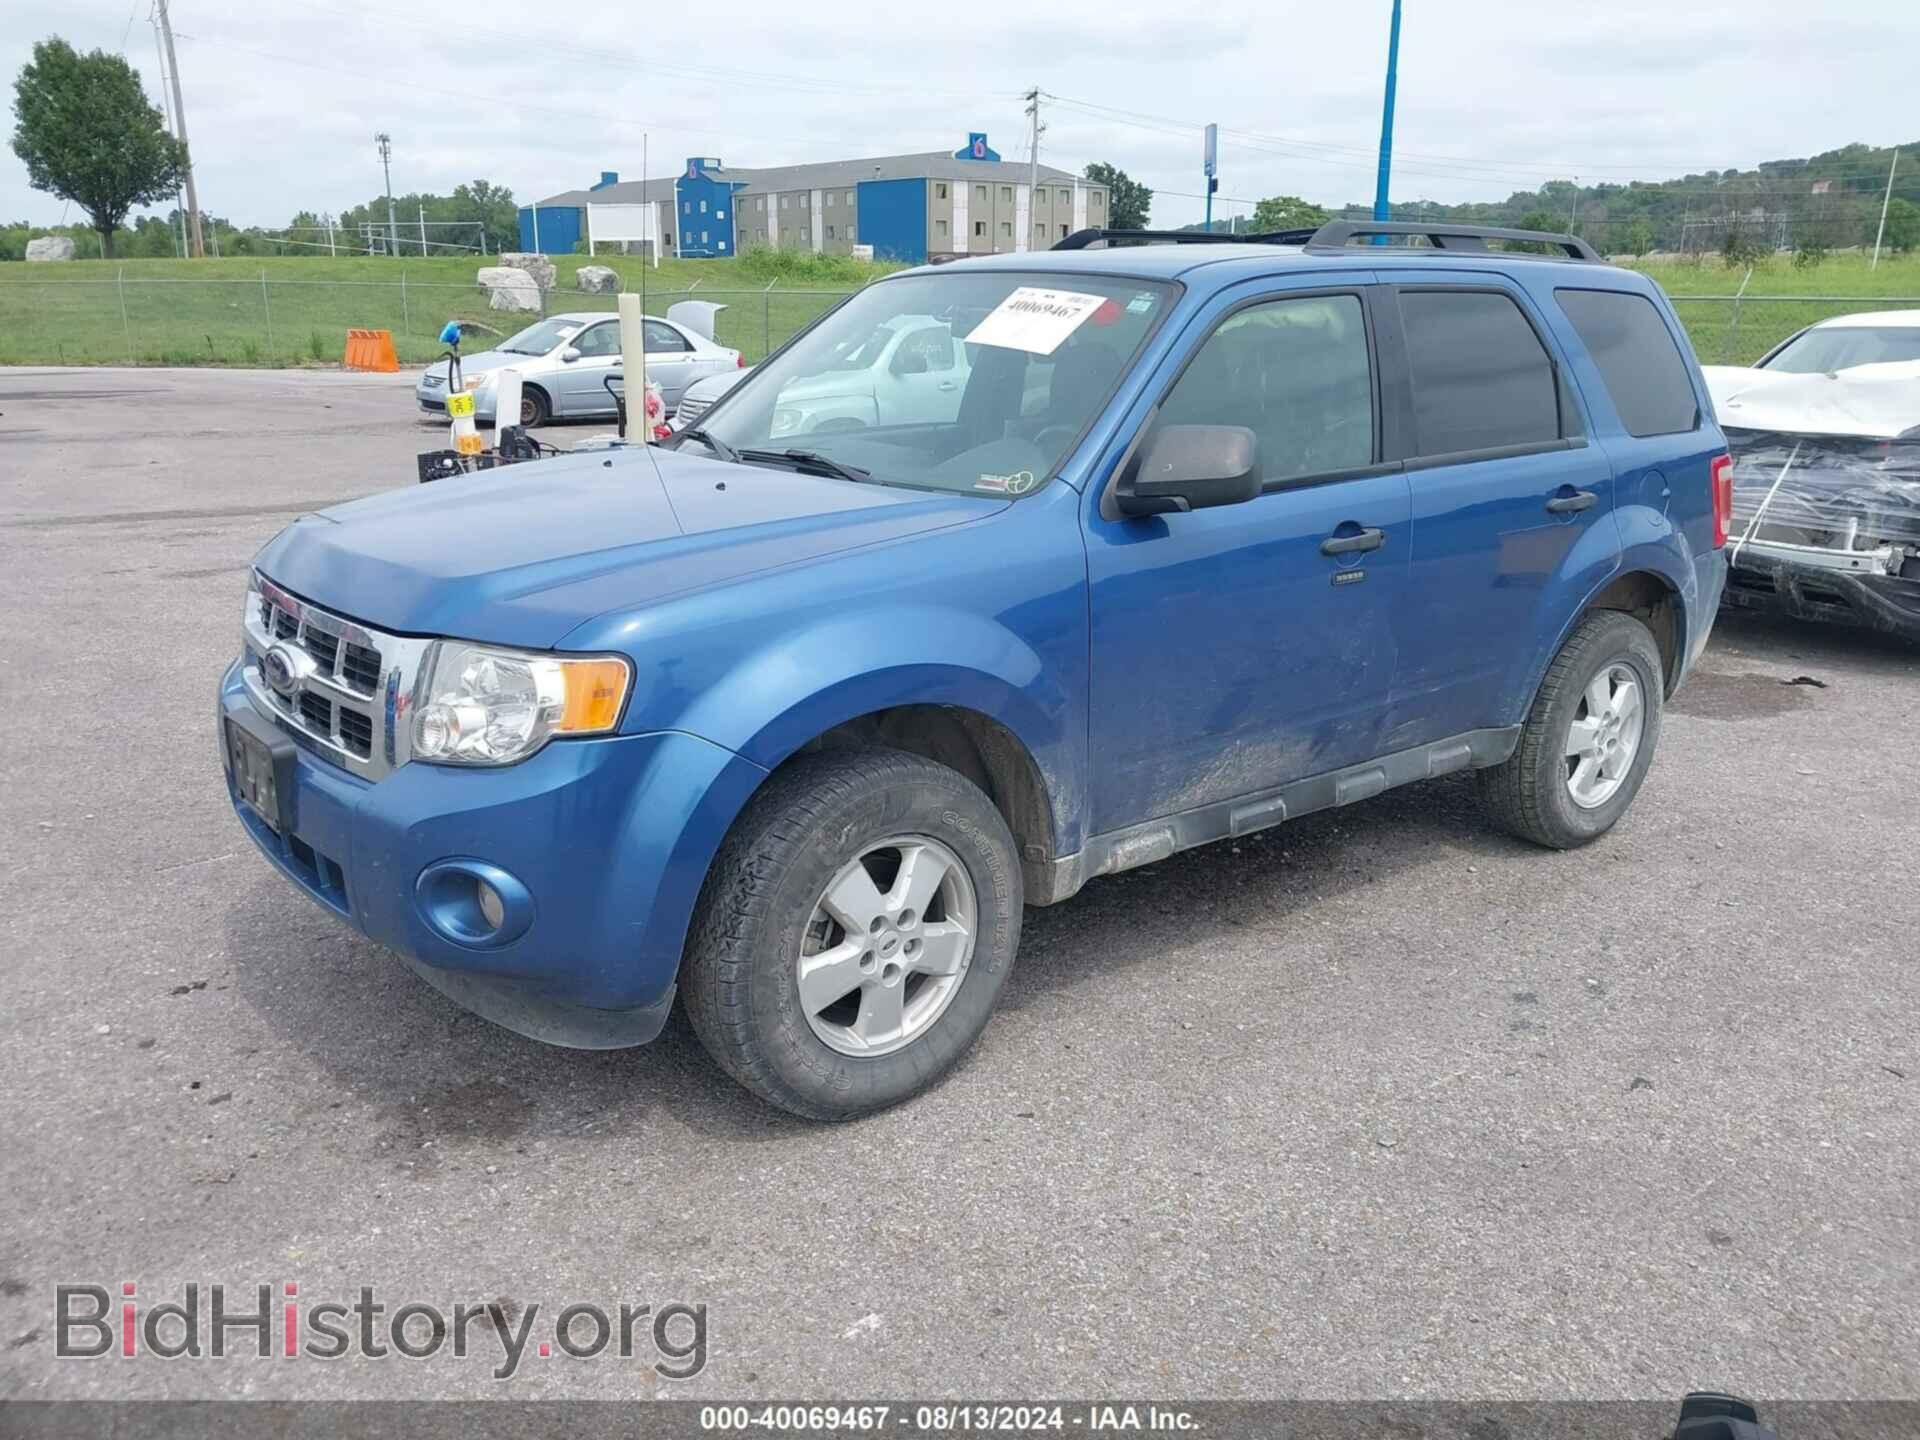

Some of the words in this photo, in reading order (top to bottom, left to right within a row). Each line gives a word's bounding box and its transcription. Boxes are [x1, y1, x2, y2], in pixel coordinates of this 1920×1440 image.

[974, 136, 985, 158] 6
[689, 159, 697, 179] 6
[1008, 301, 1081, 318] 40069467
